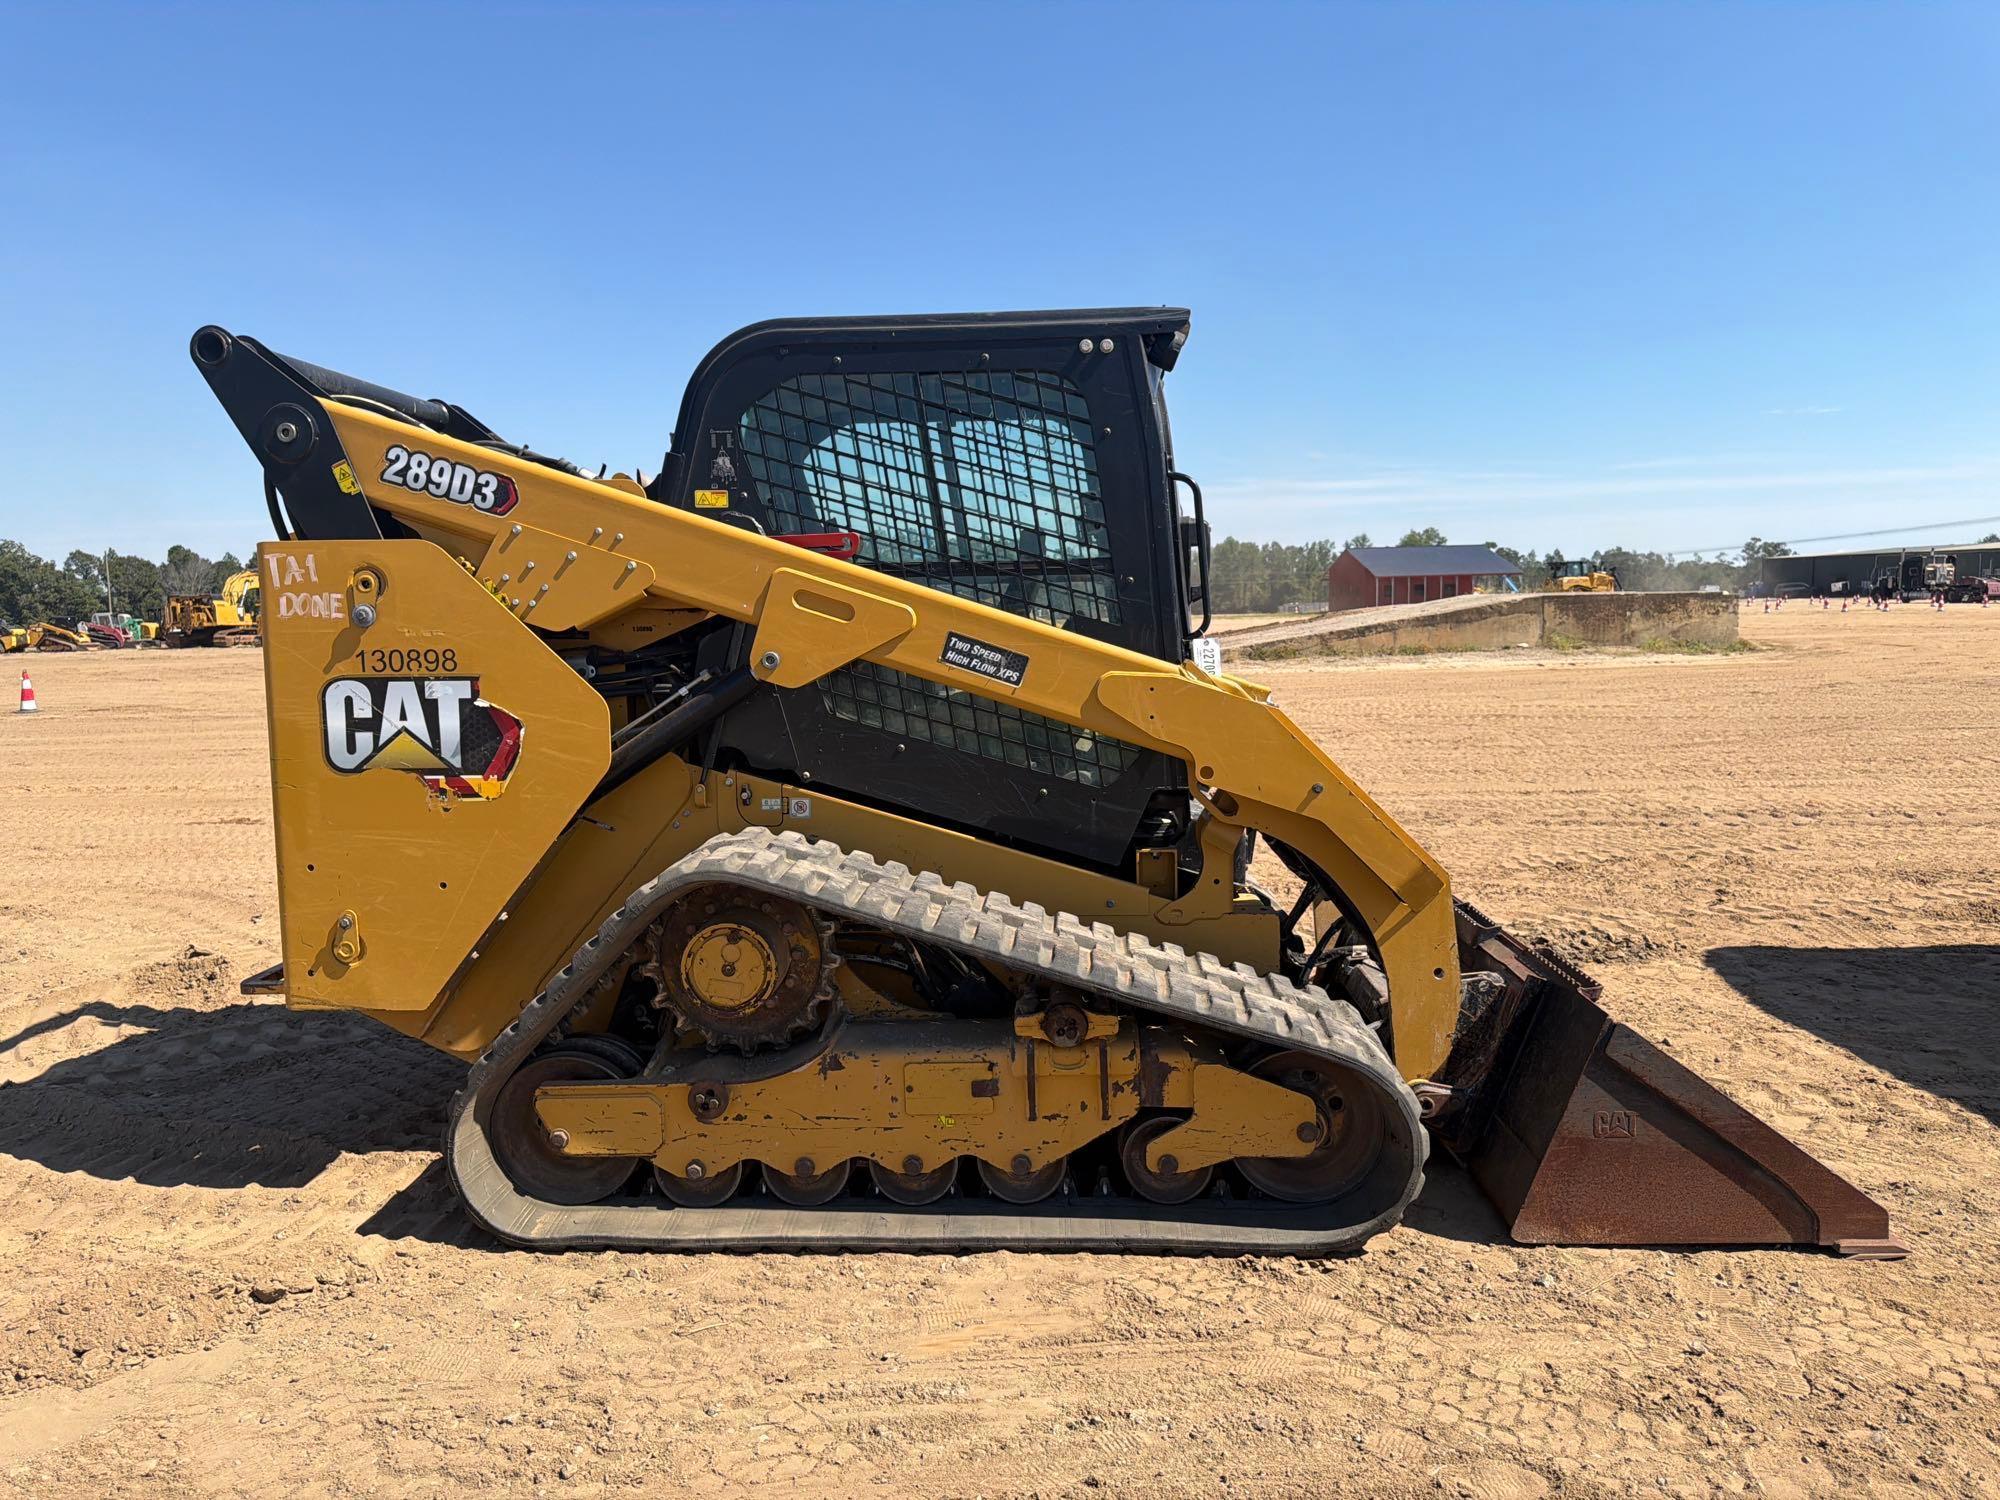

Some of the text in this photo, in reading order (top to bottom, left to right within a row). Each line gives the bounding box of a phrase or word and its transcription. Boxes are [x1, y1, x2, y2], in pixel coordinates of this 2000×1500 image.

[382, 446, 498, 510] 289D3
[278, 592, 345, 618] DONE
[355, 648, 458, 673] 130898
[948, 637, 1002, 662] TWO SPEED
[945, 650, 968, 666] HIGH
[997, 667, 1020, 682] XPS
[325, 680, 472, 769] CAT
[1593, 1110, 1640, 1139] CAT
